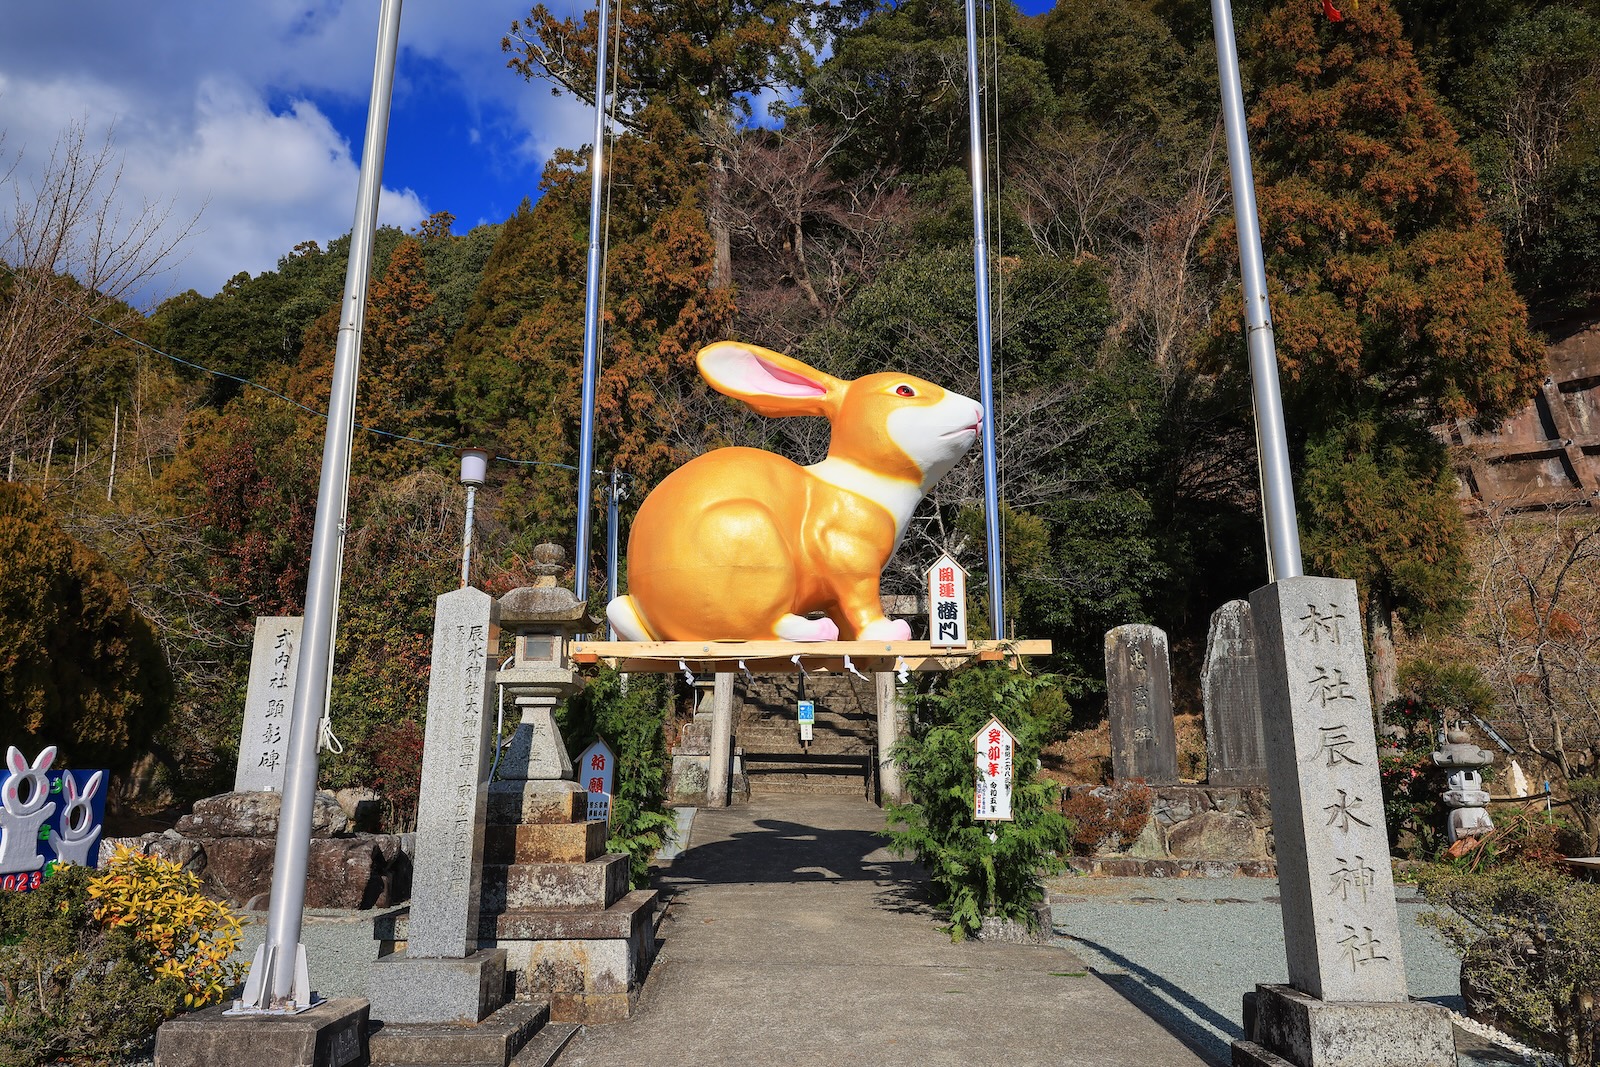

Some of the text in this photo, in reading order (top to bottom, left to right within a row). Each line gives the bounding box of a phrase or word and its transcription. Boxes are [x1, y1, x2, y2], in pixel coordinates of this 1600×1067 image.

[258, 628, 294, 773] 式内社顕彰碑
[588, 753, 606, 794] 祈願
[987, 728, 1001, 777] 癸卯年
[989, 781, 998, 813] 令和五年
[1300, 602, 1390, 973] 村社辰水神社
[0, 871, 42, 891] 023
